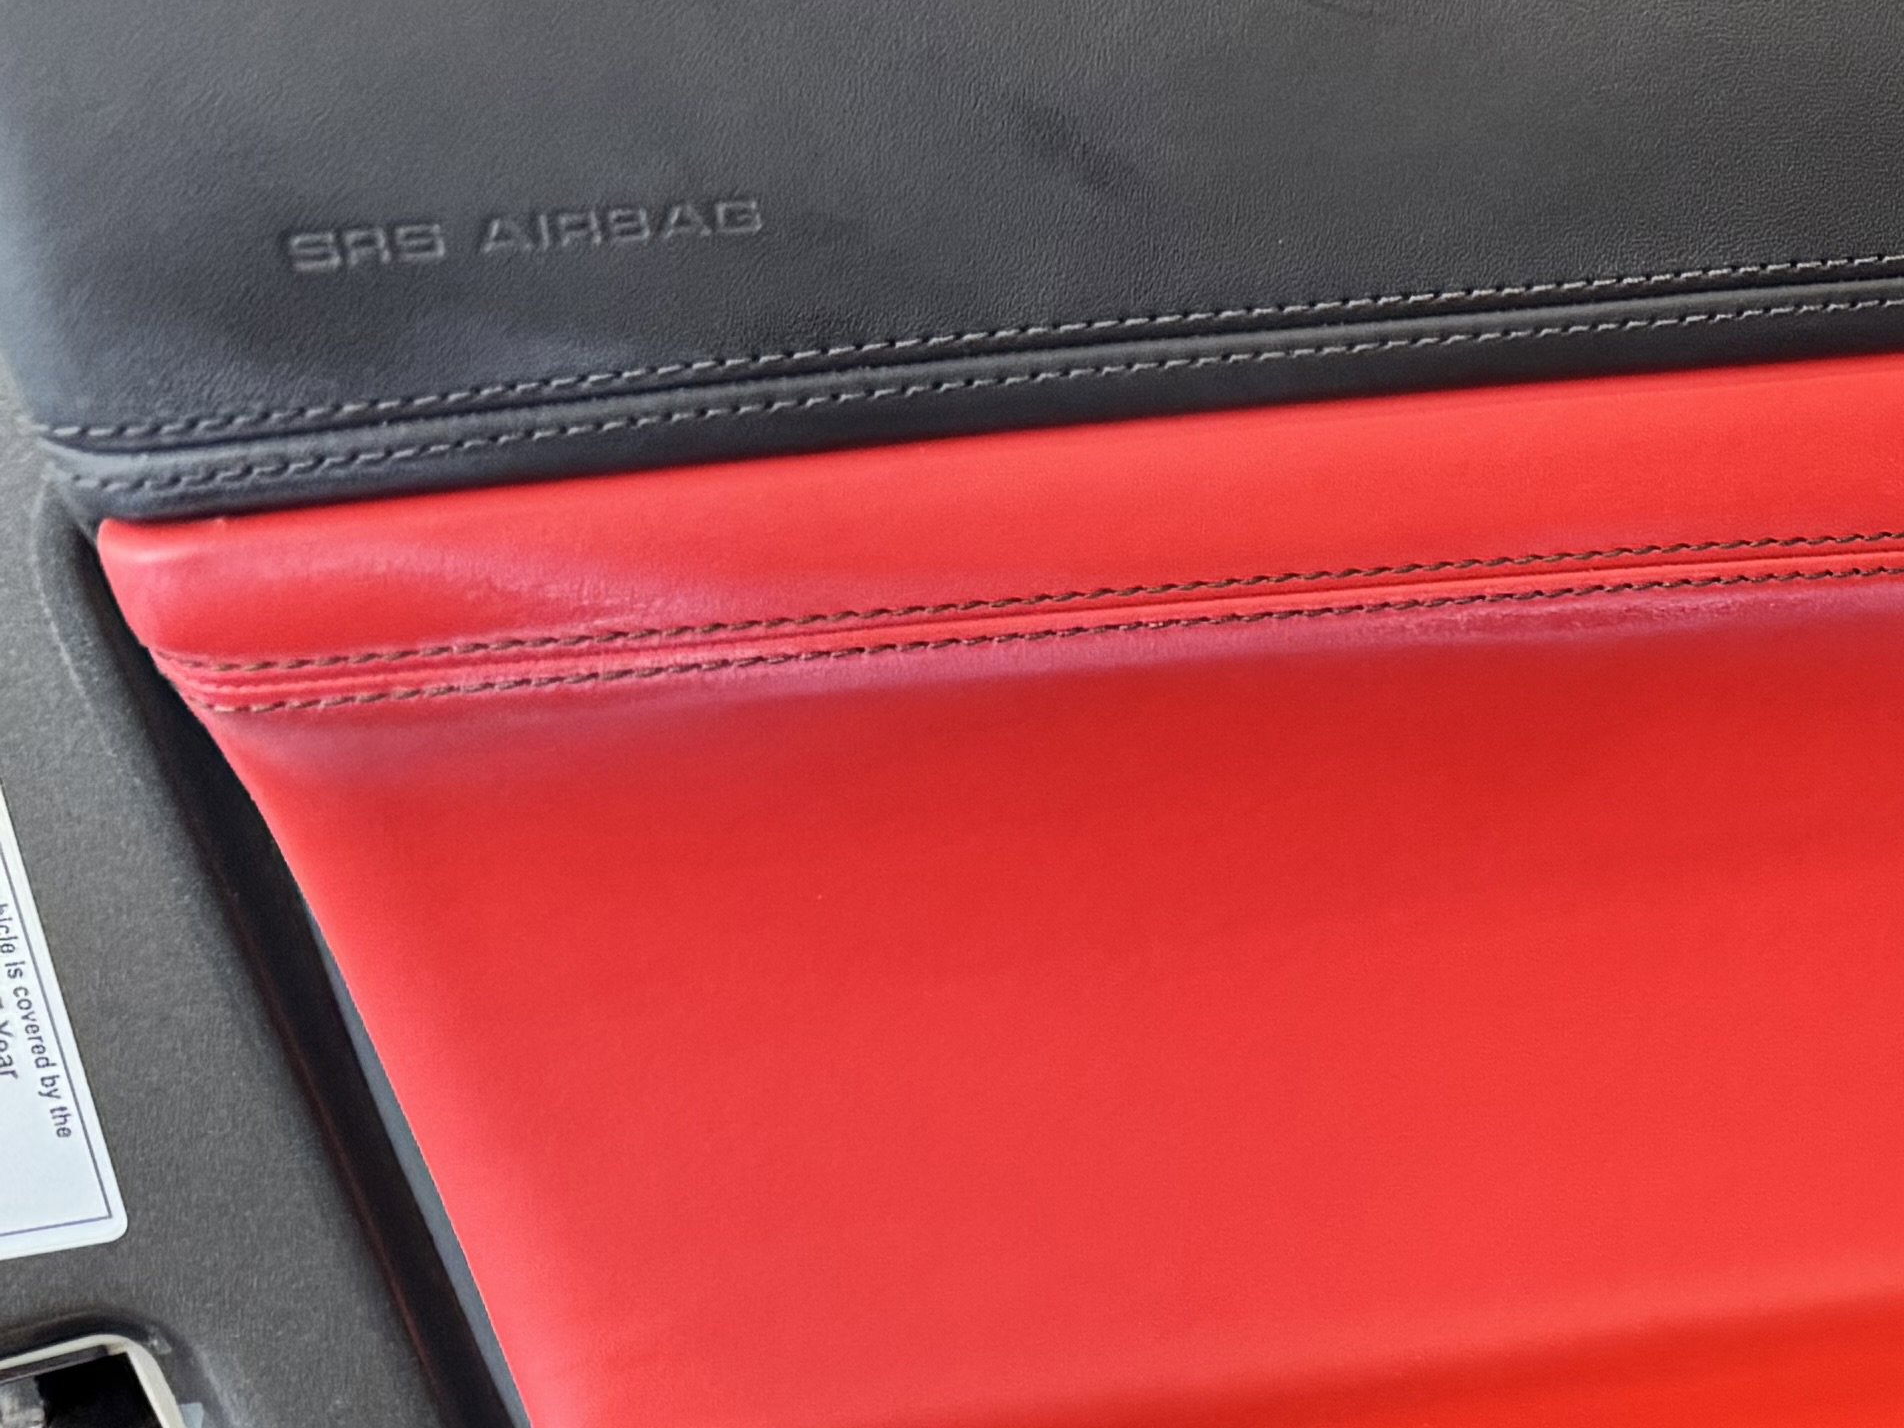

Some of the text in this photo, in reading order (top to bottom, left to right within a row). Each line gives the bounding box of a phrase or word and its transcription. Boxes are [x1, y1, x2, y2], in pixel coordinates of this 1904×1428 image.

[287, 197, 764, 274] SRS AIRBAG
[5, 961, 26, 980] is
[13, 986, 57, 1068] covered
[38, 1074, 61, 1100] by
[50, 1105, 72, 1138] the
